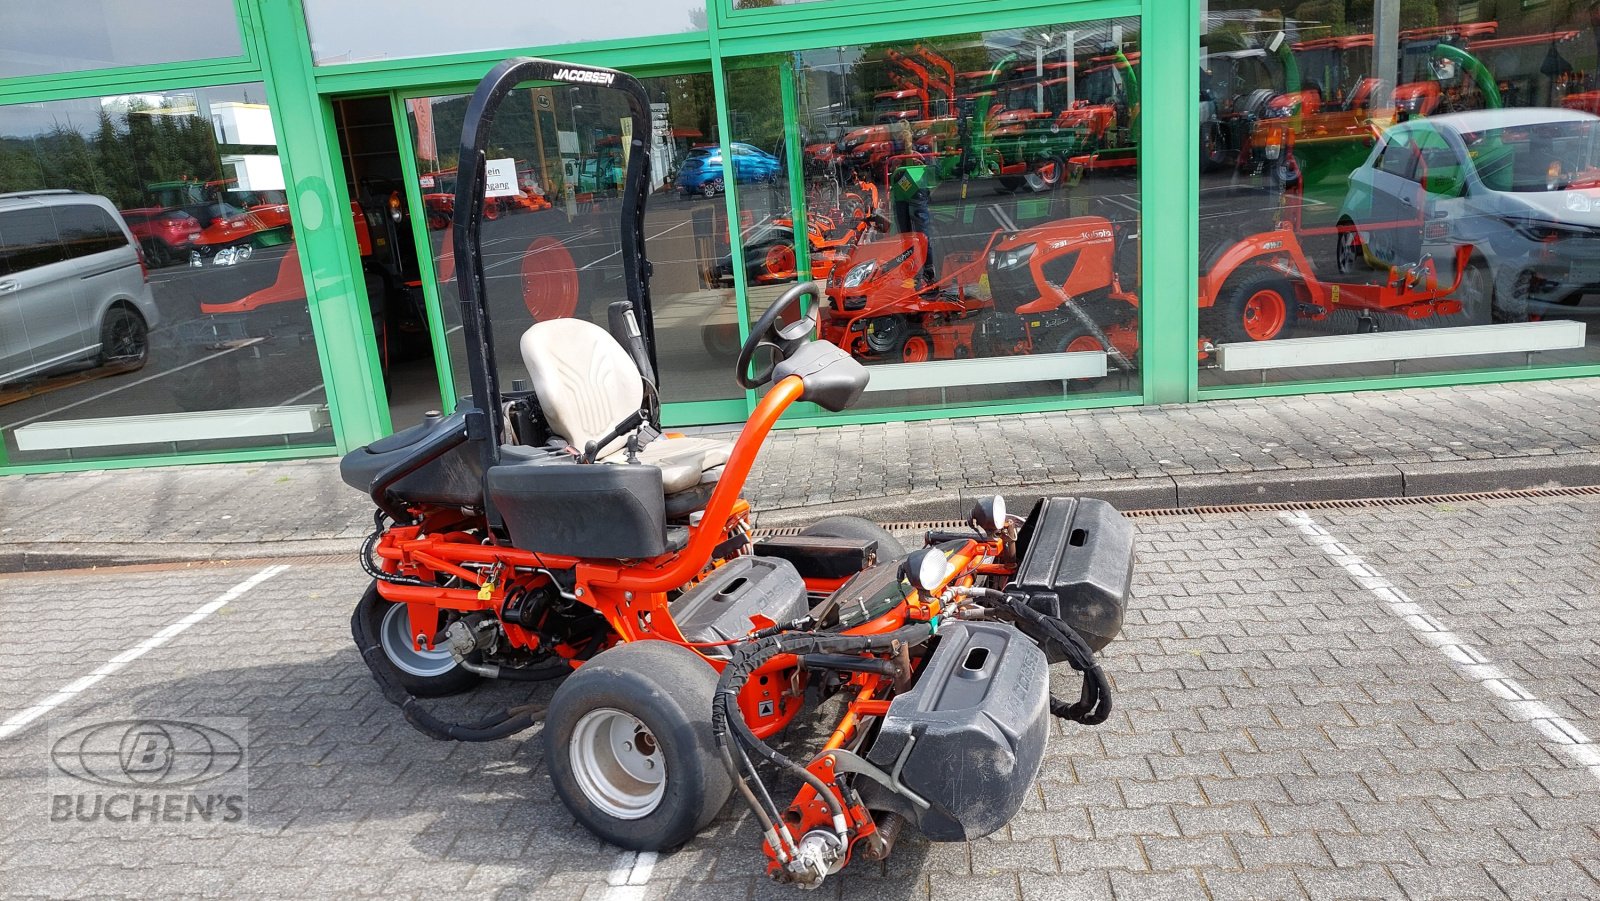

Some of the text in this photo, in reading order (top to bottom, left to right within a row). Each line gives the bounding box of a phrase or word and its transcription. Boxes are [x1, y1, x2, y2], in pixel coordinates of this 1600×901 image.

[553, 68, 615, 84] JACOBSEN
[487, 167, 501, 176] ein
[486, 182, 510, 191] ngang
[1082, 229, 1112, 239] Kubota
